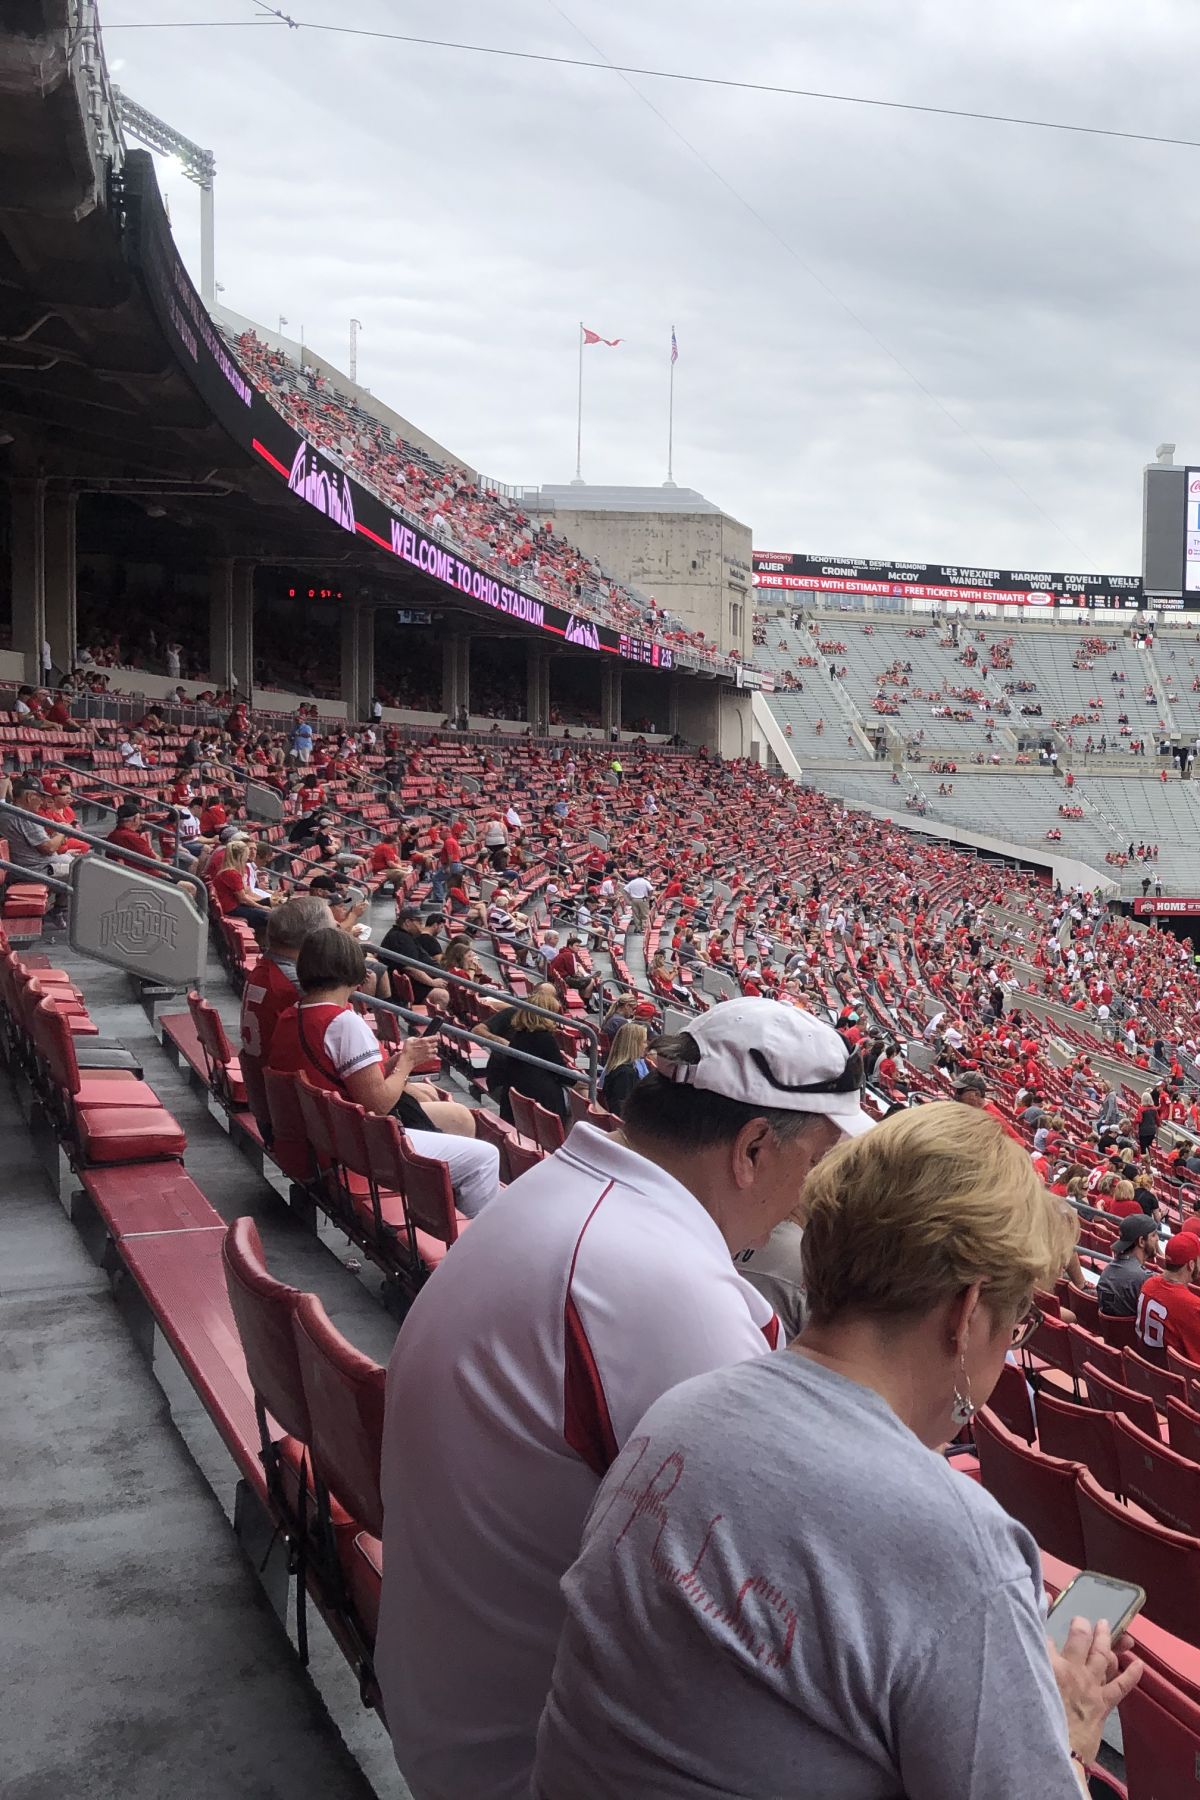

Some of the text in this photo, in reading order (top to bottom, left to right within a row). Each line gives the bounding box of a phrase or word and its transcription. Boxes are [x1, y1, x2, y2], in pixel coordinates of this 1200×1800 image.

[391, 518, 545, 627] WELCOME TO OHIO STADIUM
[758, 562, 784, 572] AUER
[822, 566, 858, 577] CRONIN
[895, 563, 927, 571] DIAMOND
[888, 571, 919, 582] McCOY
[941, 568, 1000, 580] LES WEXNER
[1011, 573, 1052, 582] HARMON
[1064, 575, 1102, 584] COVELLI
[762, 575, 889, 593] FREE TICKETS WITH ESTIMATE!
[950, 576, 994, 587] WANDELL
[1030, 581, 1085, 592] WOLFE FDN
[1108, 577, 1140, 586] WELLS
[905, 586, 924, 596] FREE
[926, 587, 958, 598] TICKETS
[960, 590, 982, 600] WITH
[983, 592, 1025, 602] ESTIMATE!
[1157, 902, 1186, 911] HOME
[1135, 1293, 1168, 1348] 16
